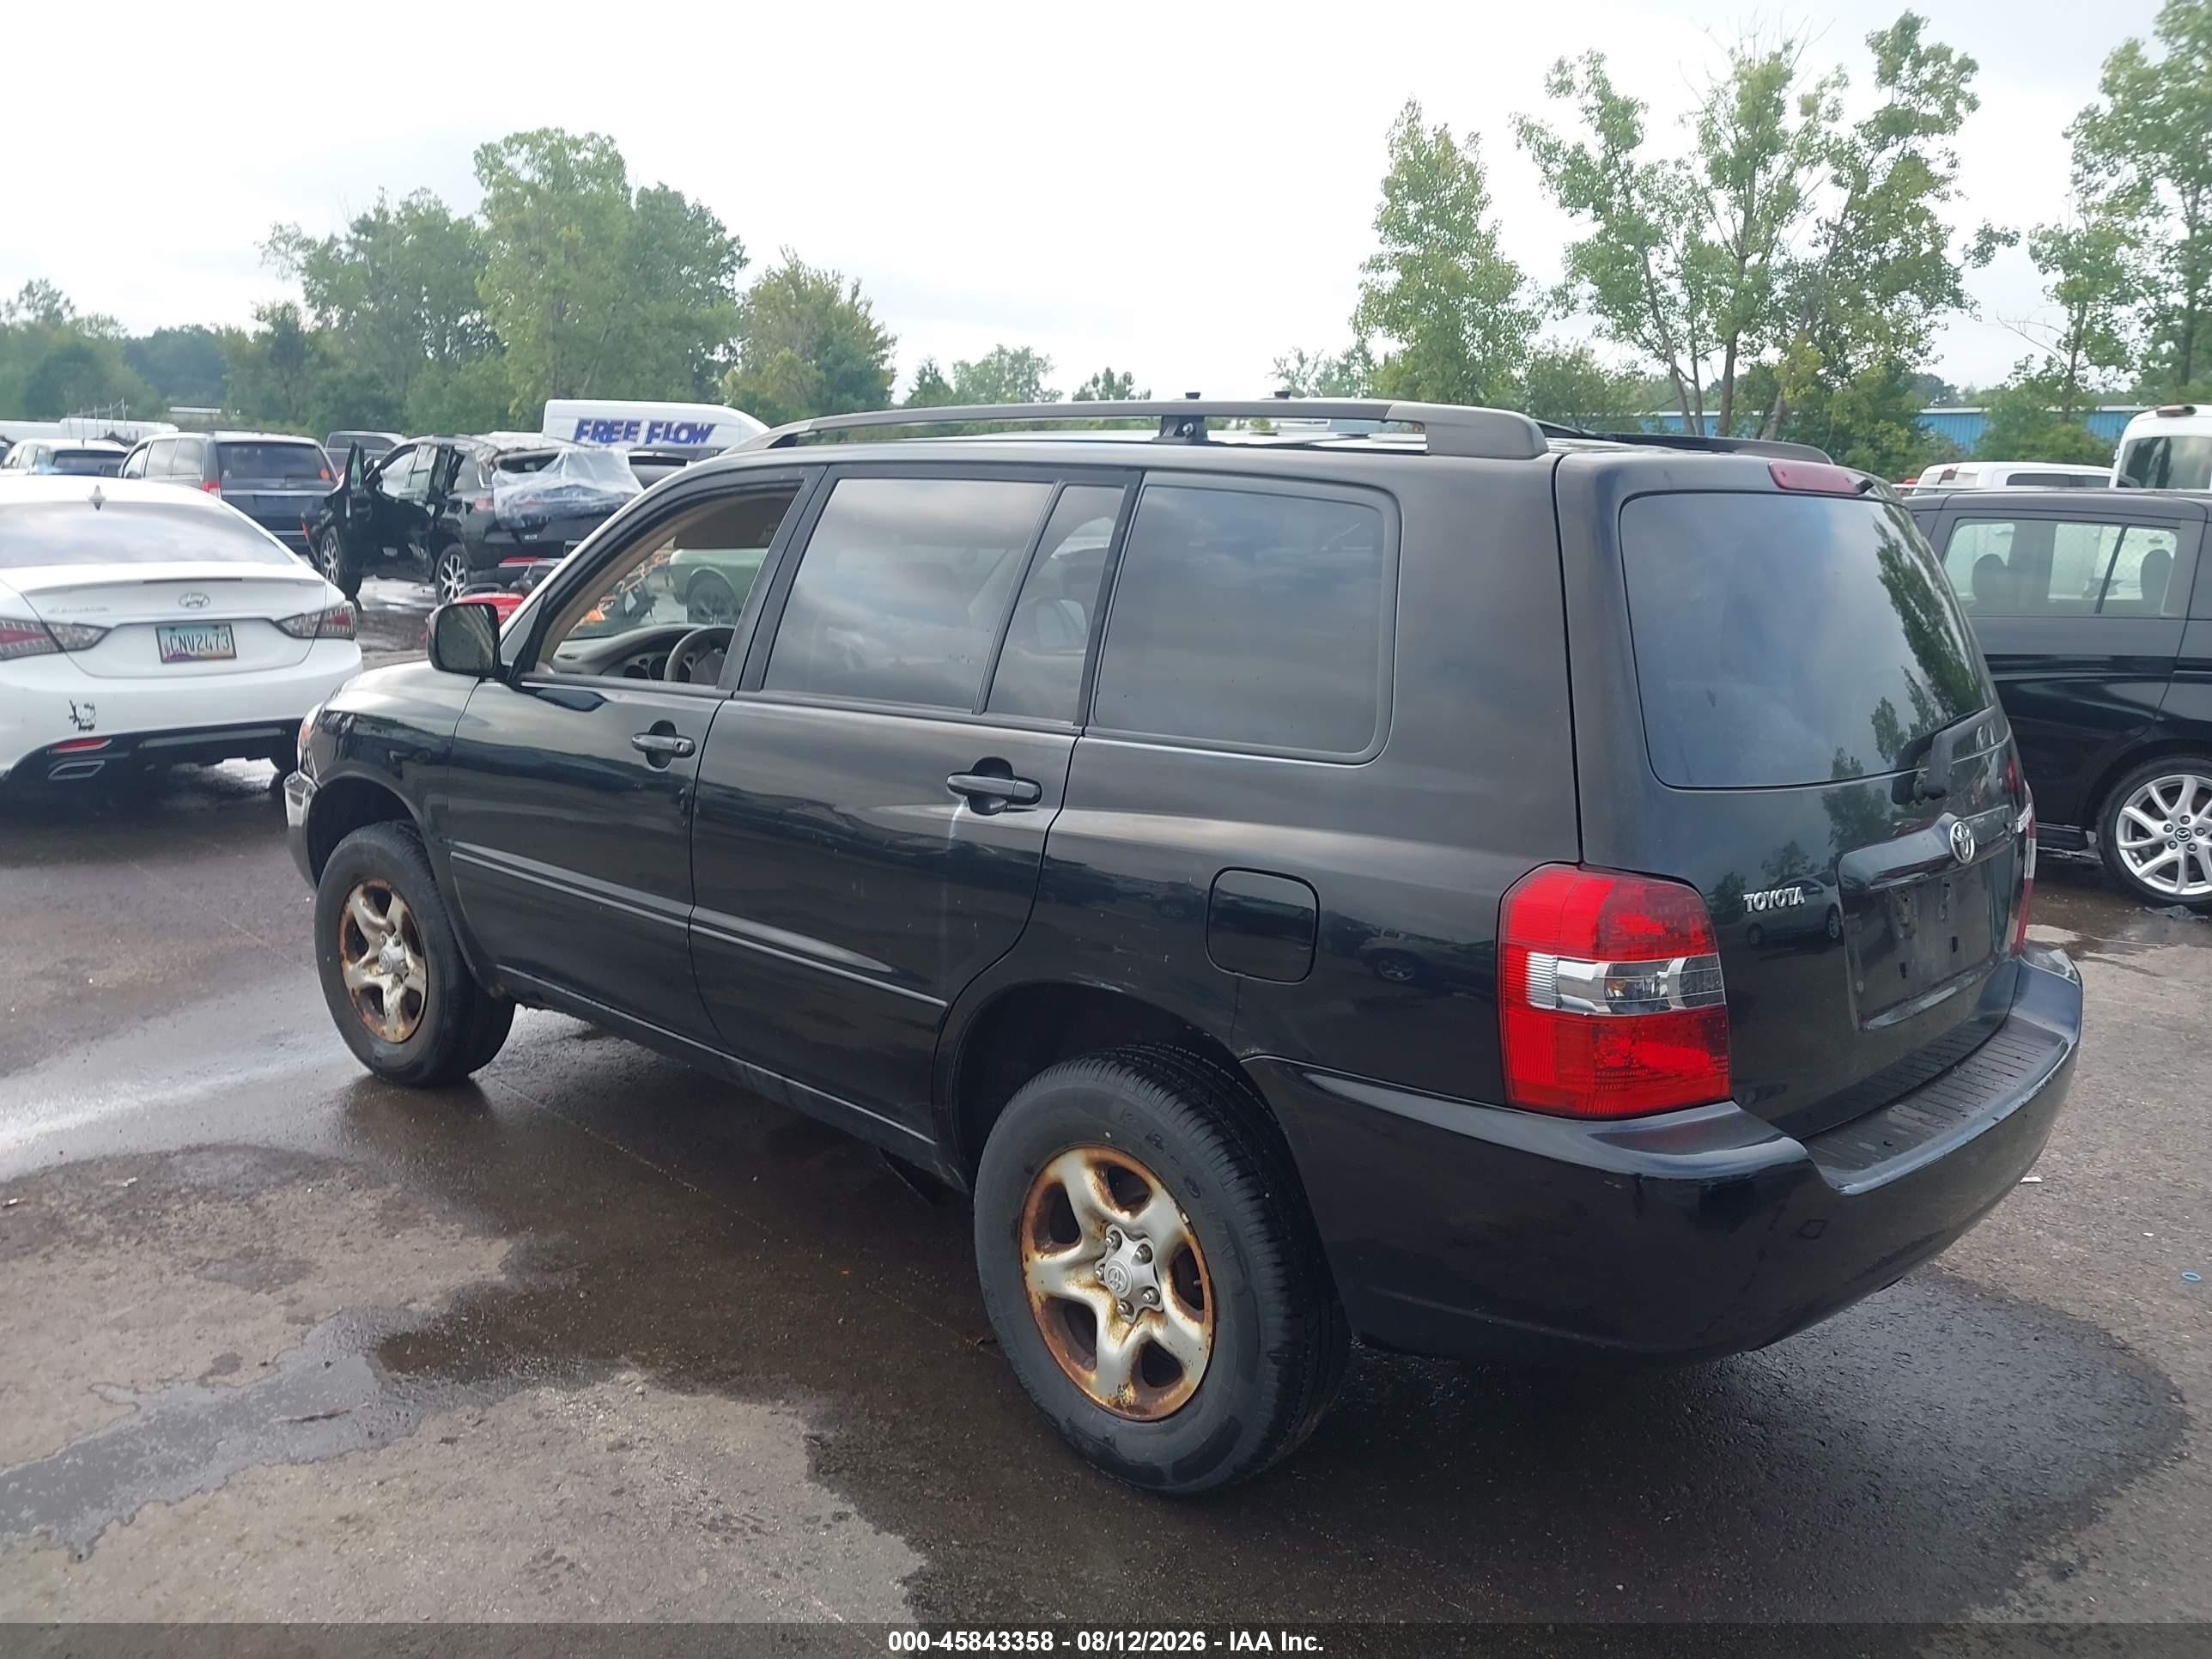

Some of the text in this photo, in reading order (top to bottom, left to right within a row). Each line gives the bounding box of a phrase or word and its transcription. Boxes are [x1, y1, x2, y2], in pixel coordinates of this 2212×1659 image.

[574, 418, 716, 444] FREE FLOW
[170, 633, 229, 653] CNV2473
[1742, 886, 1805, 913] TOYOTA
